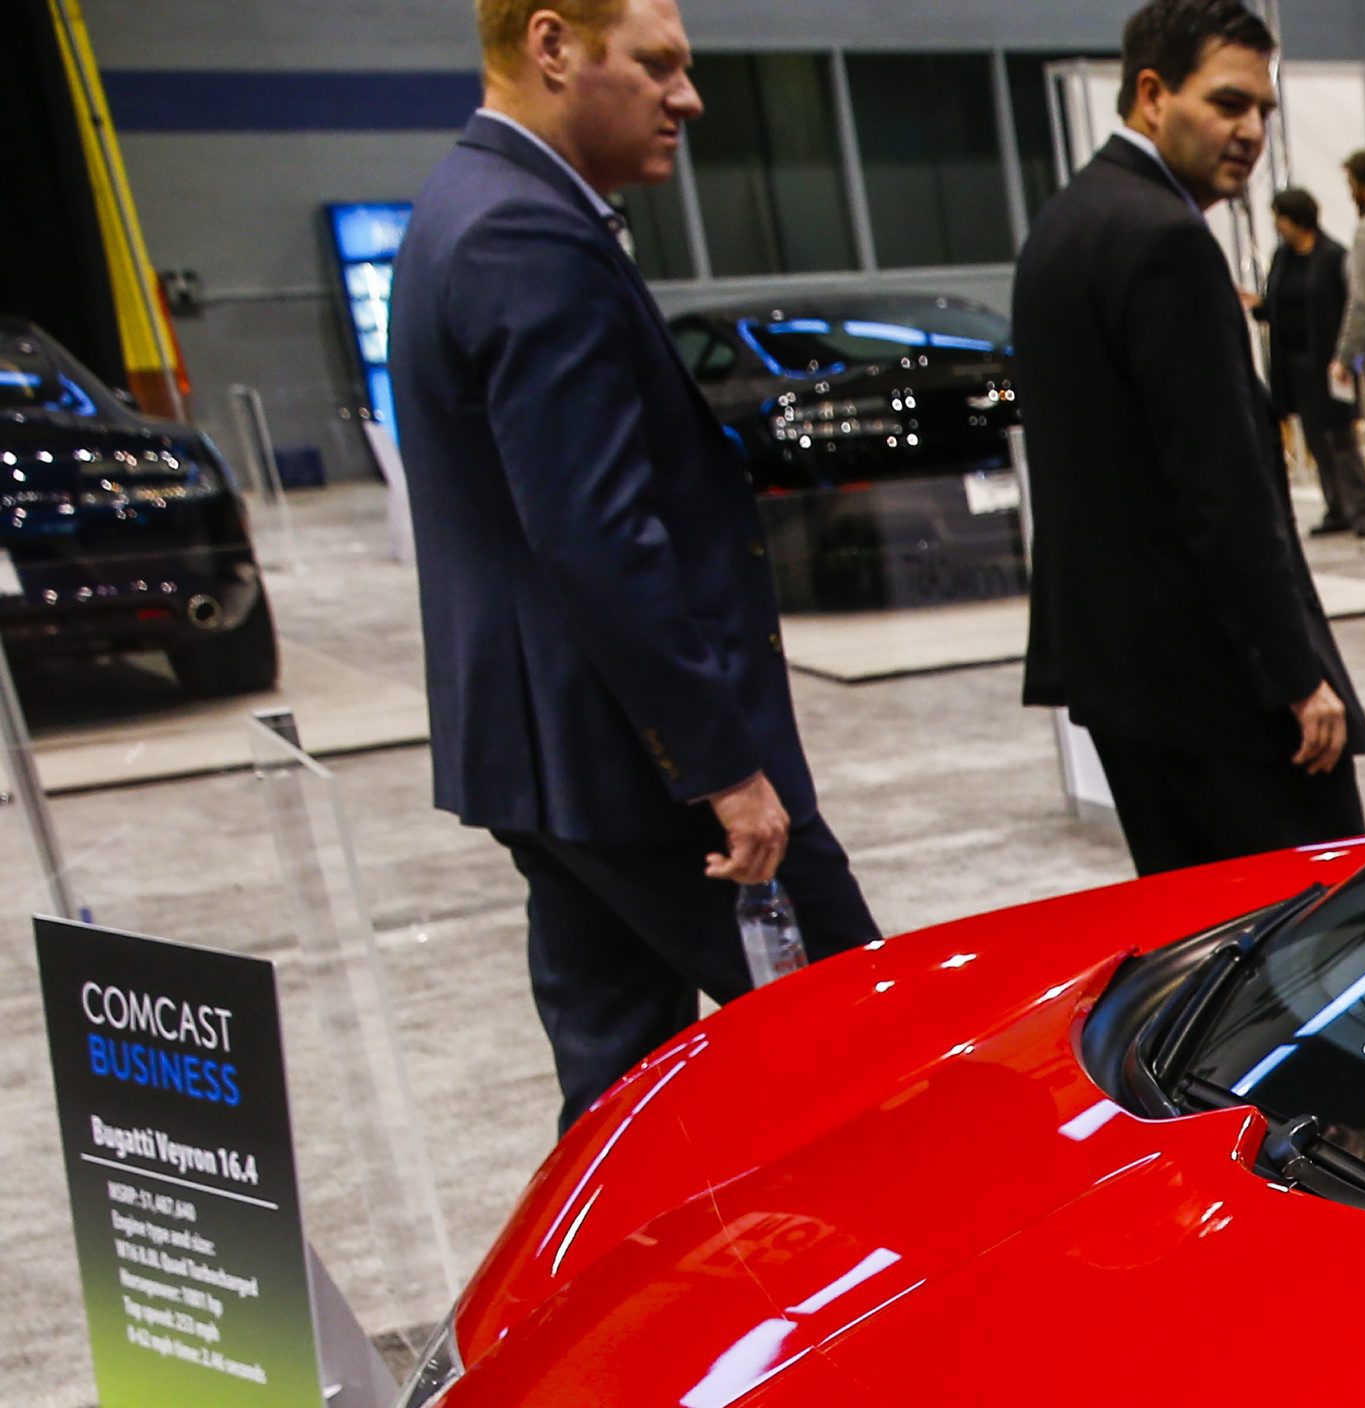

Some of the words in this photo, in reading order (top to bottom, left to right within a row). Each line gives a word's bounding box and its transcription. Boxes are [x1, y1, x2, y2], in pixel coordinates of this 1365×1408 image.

[82, 980, 233, 1053] COMCAST
[87, 1032, 241, 1107] BUSINESS
[91, 1114, 156, 1159] Bugatti
[155, 1131, 218, 1174] Veyron
[217, 1148, 259, 1185] 16.4
